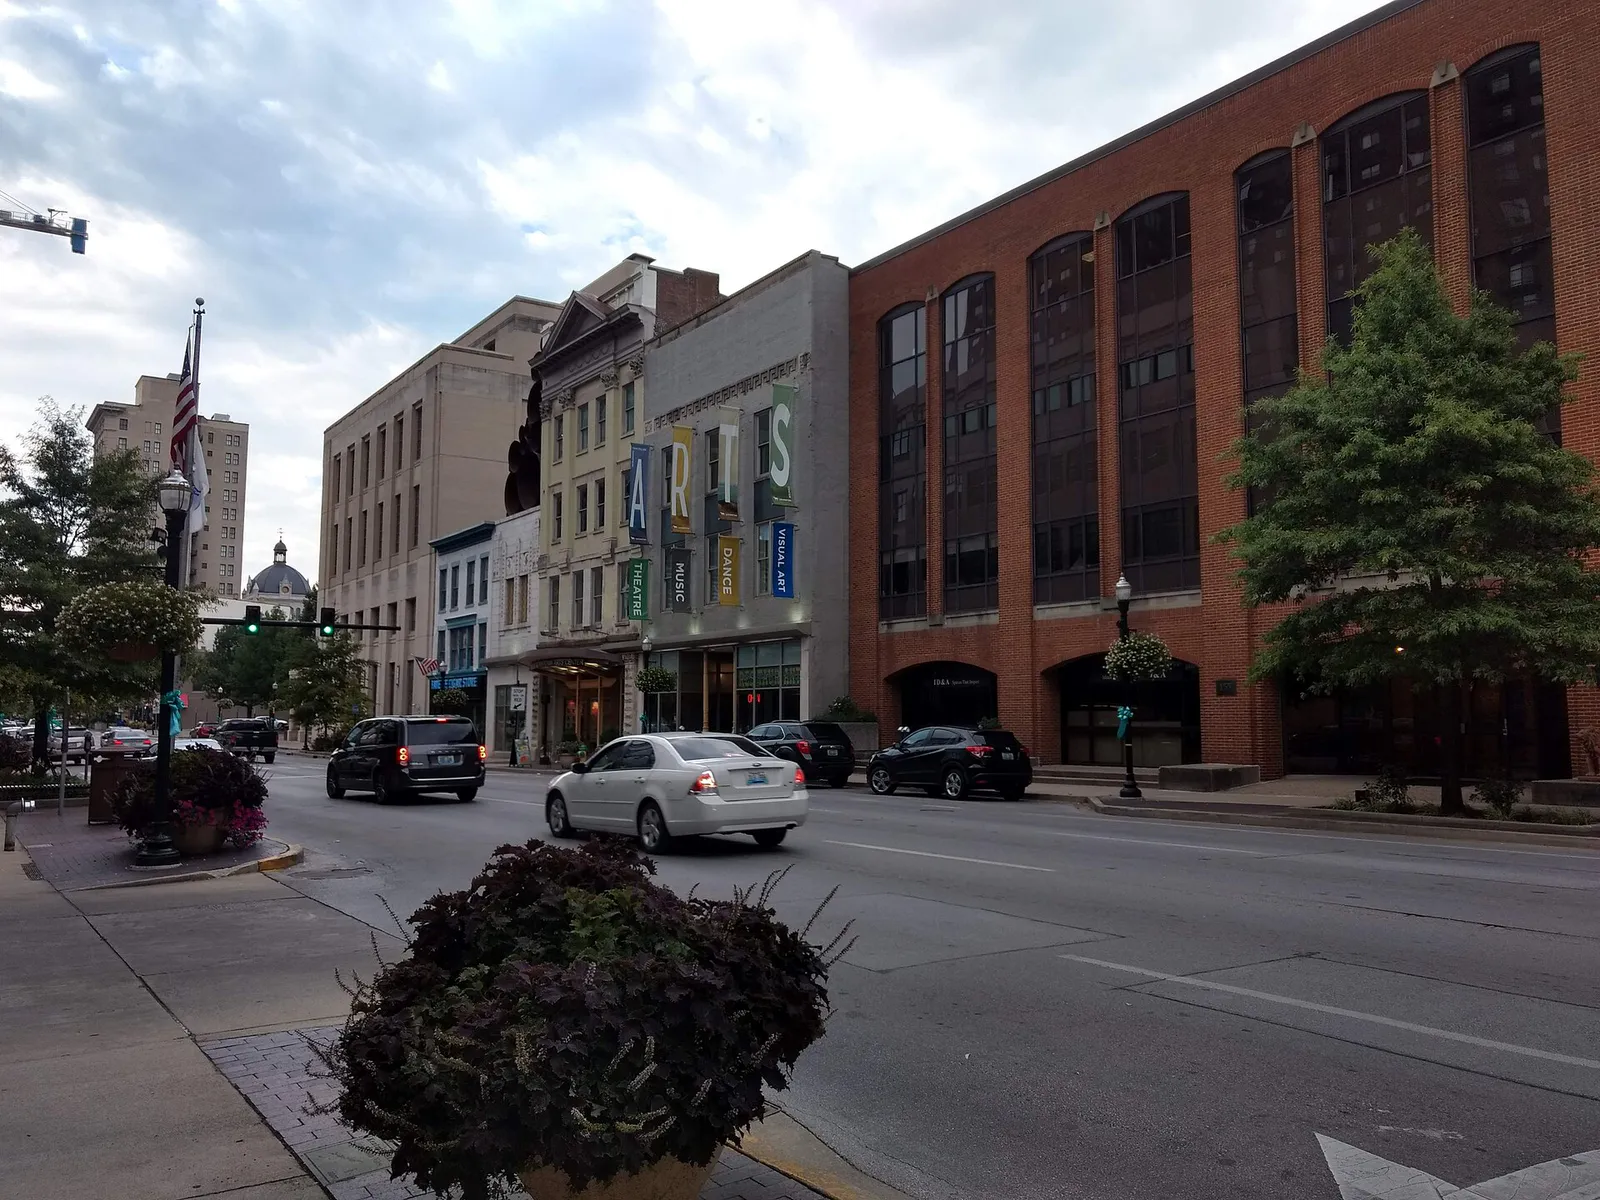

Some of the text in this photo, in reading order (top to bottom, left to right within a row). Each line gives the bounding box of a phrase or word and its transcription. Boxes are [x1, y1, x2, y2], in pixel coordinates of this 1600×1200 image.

[630, 403, 790, 528] A R T S
[675, 562, 685, 602] MUSIC
[722, 547, 733, 595] DANCE
[777, 528, 786, 593] VISUAL ART
[633, 562, 643, 616] THEATRE
